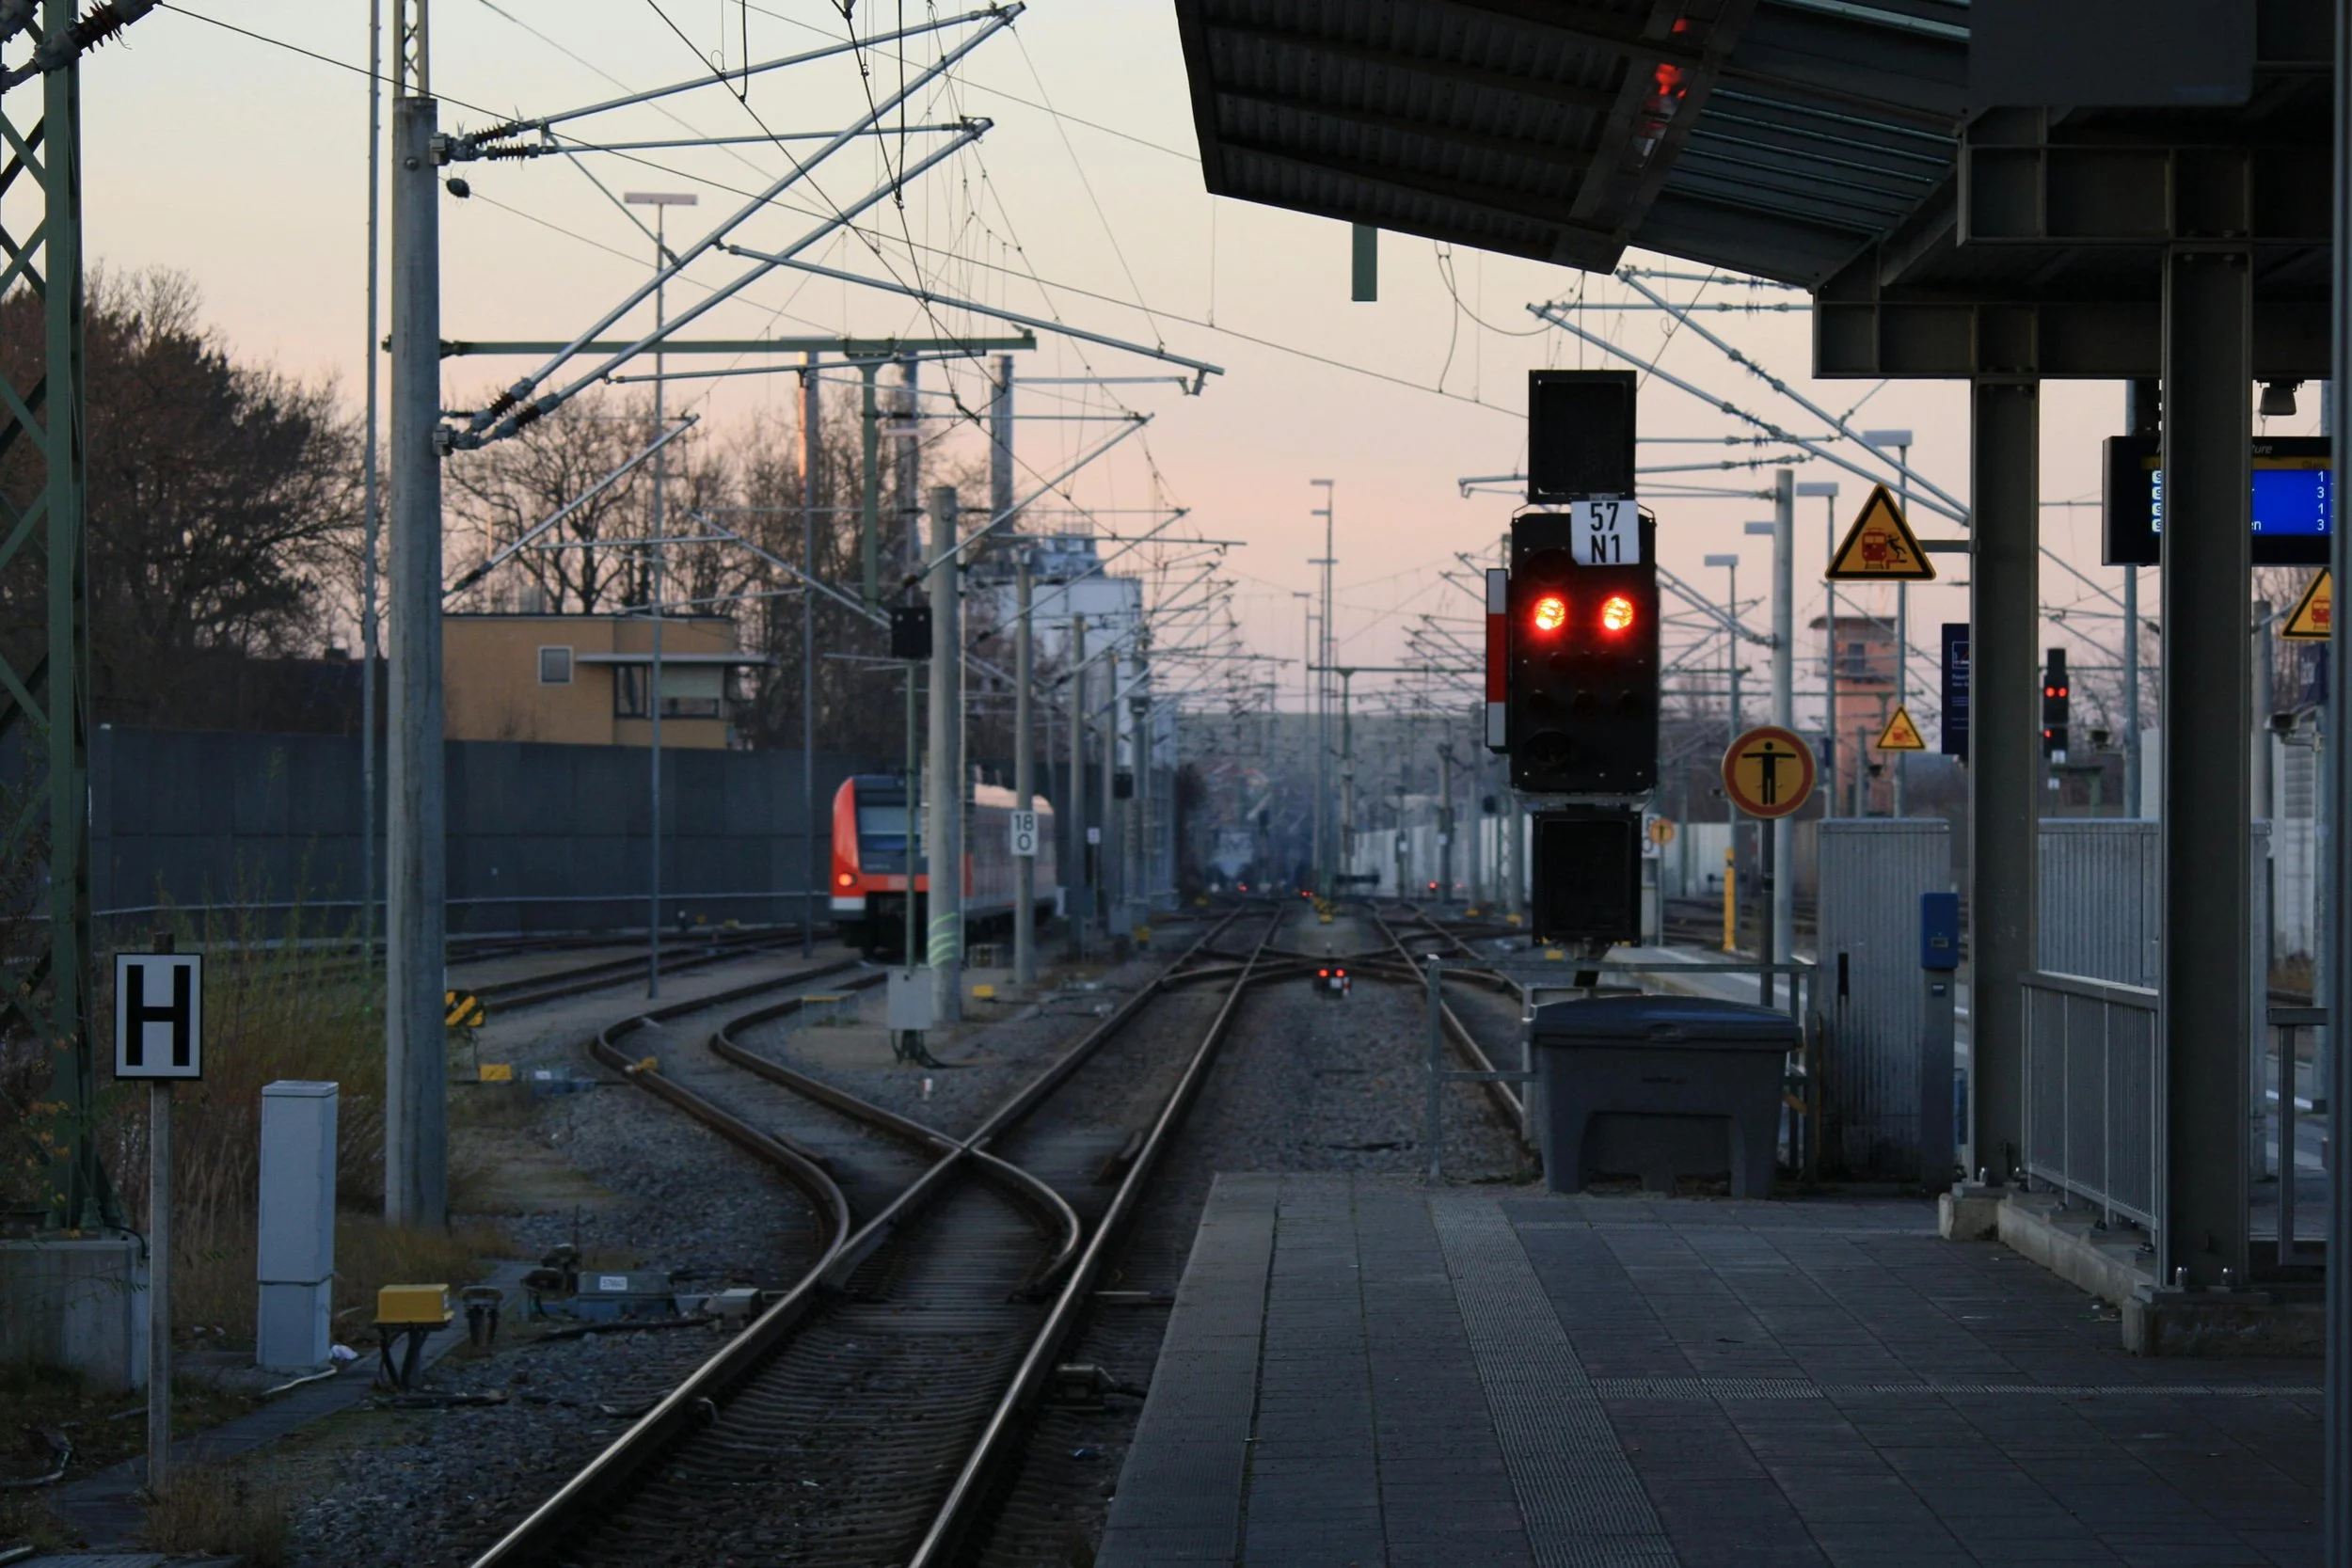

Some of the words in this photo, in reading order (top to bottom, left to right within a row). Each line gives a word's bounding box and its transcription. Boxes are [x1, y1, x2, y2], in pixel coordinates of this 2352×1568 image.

[2317, 470, 2324, 483] 1
[2316, 486, 2325, 499] 3
[2317, 502, 2324, 515] 1
[1590, 502, 1619, 531] 57
[2316, 518, 2325, 531] 3
[1591, 534, 1620, 563] N1
[1015, 815, 1034, 832] 18
[126, 965, 191, 1067] H
